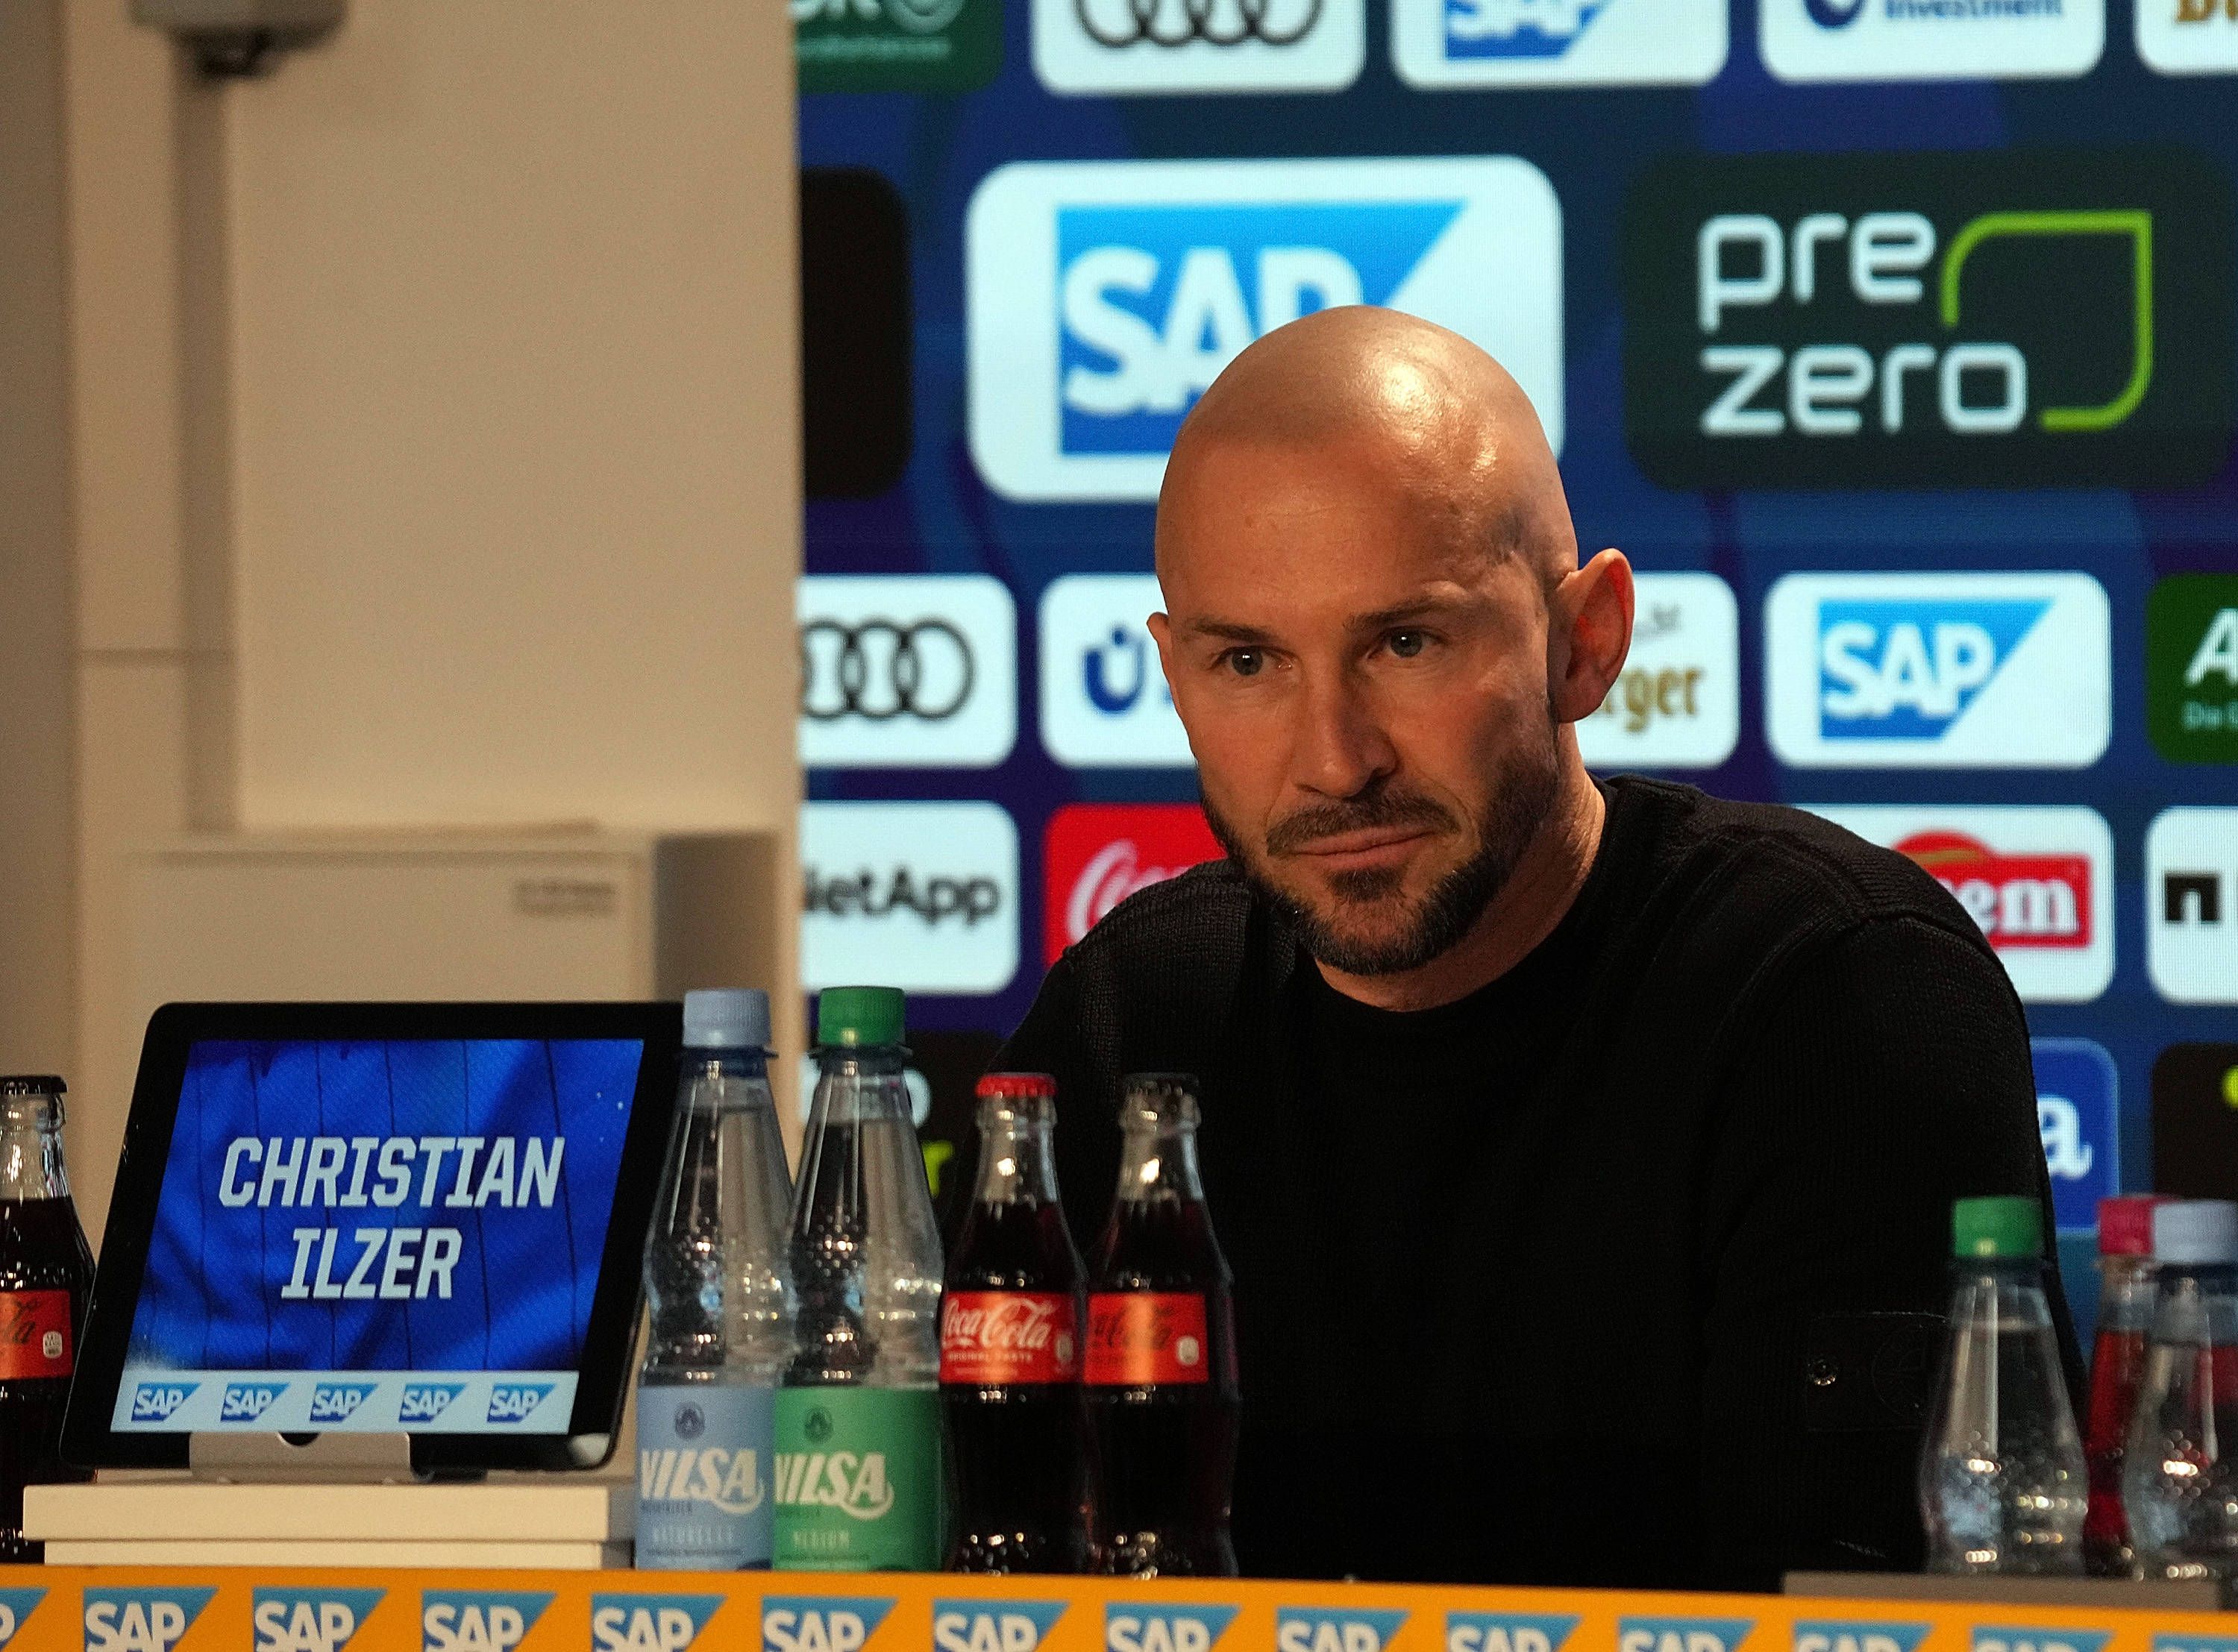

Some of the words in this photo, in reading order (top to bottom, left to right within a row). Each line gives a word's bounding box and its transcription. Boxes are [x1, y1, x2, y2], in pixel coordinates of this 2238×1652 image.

[1698, 212, 1936, 333] pre
[1701, 343, 2028, 436] zero
[1824, 621, 1996, 720] SAP
[219, 1136, 565, 1208] CHRISTIAN
[280, 1228, 463, 1299] ILZER
[135, 1388, 184, 1416] SAP
[224, 1389, 272, 1416] SAP
[313, 1389, 362, 1416] SAP
[402, 1389, 450, 1416] SAP
[491, 1389, 539, 1416] SAP
[642, 1448, 765, 1514] VILSA
[85, 1601, 185, 1652] SAP
[254, 1601, 354, 1652] SAP
[423, 1604, 523, 1652] SAP
[592, 1607, 693, 1652] SAP
[762, 1609, 865, 1652] SAP
[933, 1612, 1037, 1652] SAP
